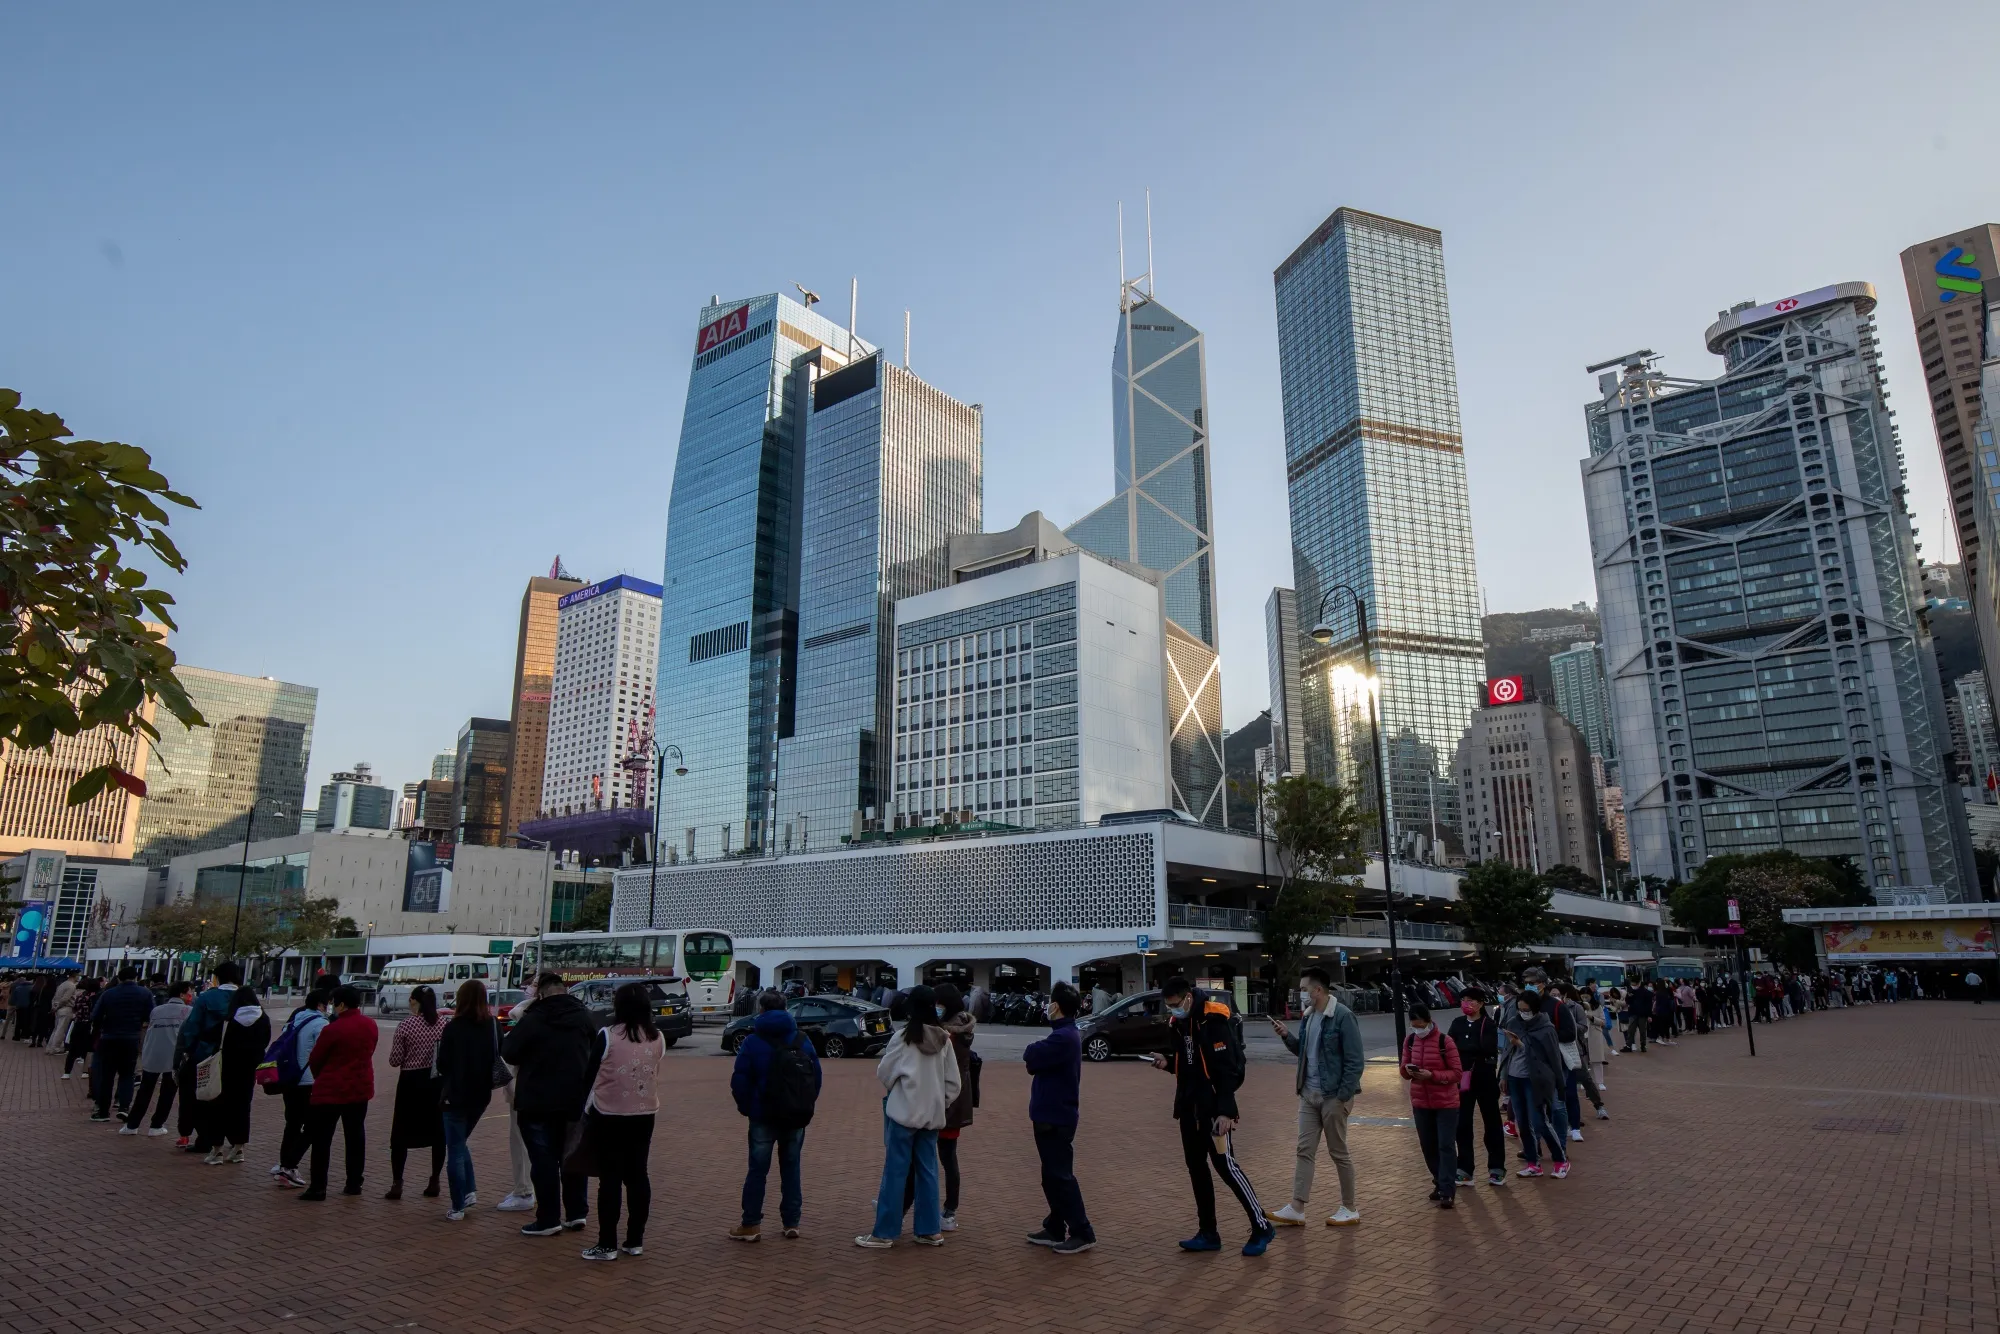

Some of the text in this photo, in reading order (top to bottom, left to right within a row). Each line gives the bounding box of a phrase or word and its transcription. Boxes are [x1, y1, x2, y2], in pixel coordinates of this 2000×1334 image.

[703, 313, 741, 349] AIA
[559, 585, 599, 607] OF AMERICA
[1138, 936, 1146, 947] P
[568, 971, 589, 982] Learning
[589, 972, 605, 981] Center
